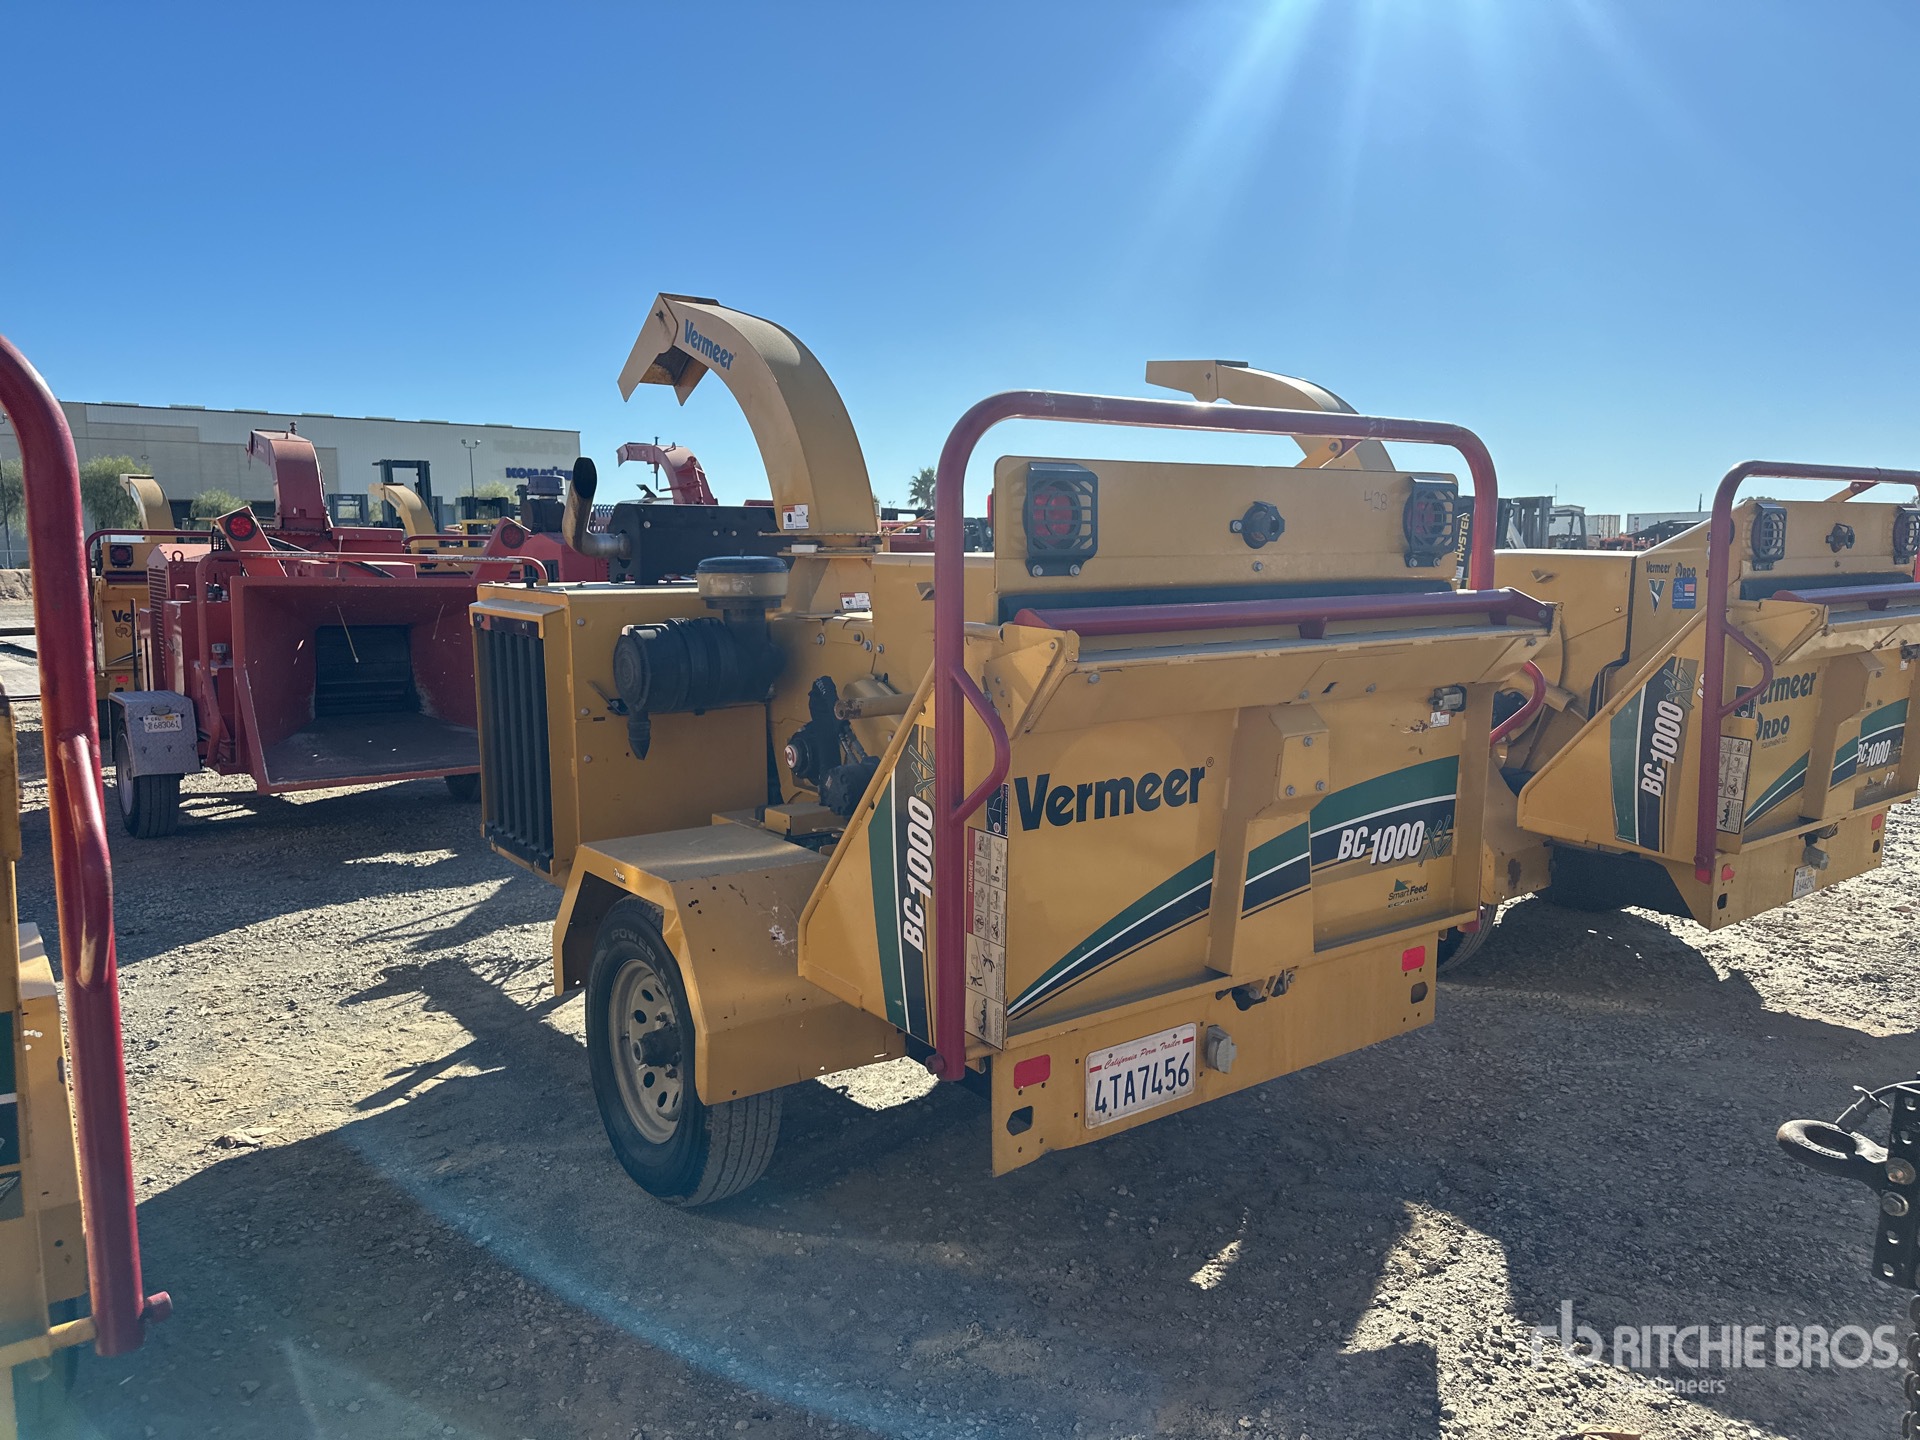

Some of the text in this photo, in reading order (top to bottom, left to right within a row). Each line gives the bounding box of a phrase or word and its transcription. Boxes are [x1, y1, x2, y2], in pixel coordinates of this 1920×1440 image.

[684, 318, 734, 371] Vermeer
[1457, 513, 1471, 562] HYSTER
[1646, 561, 1670, 573] Vermeer
[1760, 672, 1817, 705] ermeer
[1014, 766, 1206, 832] Vermeer
[1104, 1040, 1182, 1070] California Perm Trailer
[1094, 1052, 1190, 1114] 4TA7456
